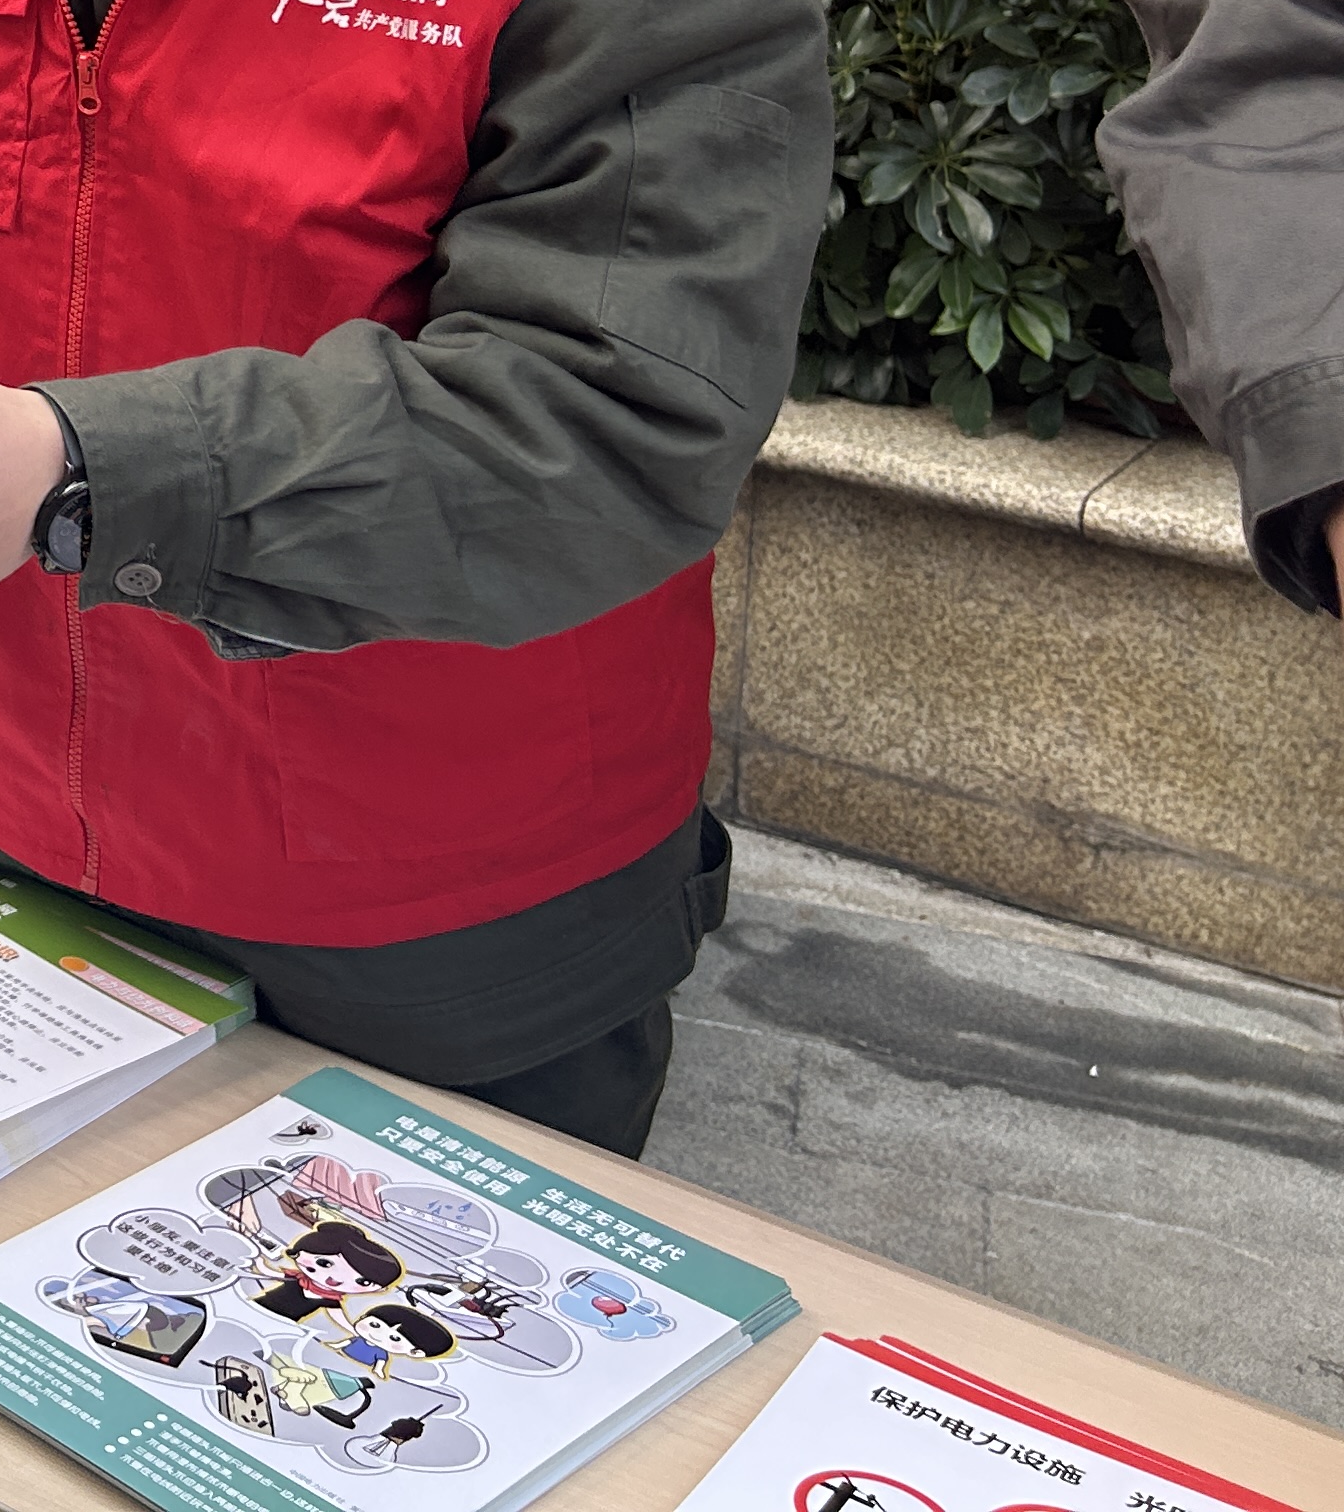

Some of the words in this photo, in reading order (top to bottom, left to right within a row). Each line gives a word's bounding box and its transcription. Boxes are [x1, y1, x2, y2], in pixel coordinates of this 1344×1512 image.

[375, 1126, 513, 1197] 只要安全使用
[521, 1198, 669, 1274] 光明无处不在
[395, 1114, 531, 1185] 电是清洁能源
[540, 1188, 687, 1262] 生活无可替代
[116, 1221, 221, 1282] 这些行为和习惯
[869, 1386, 1086, 1487] 保护电力设施
